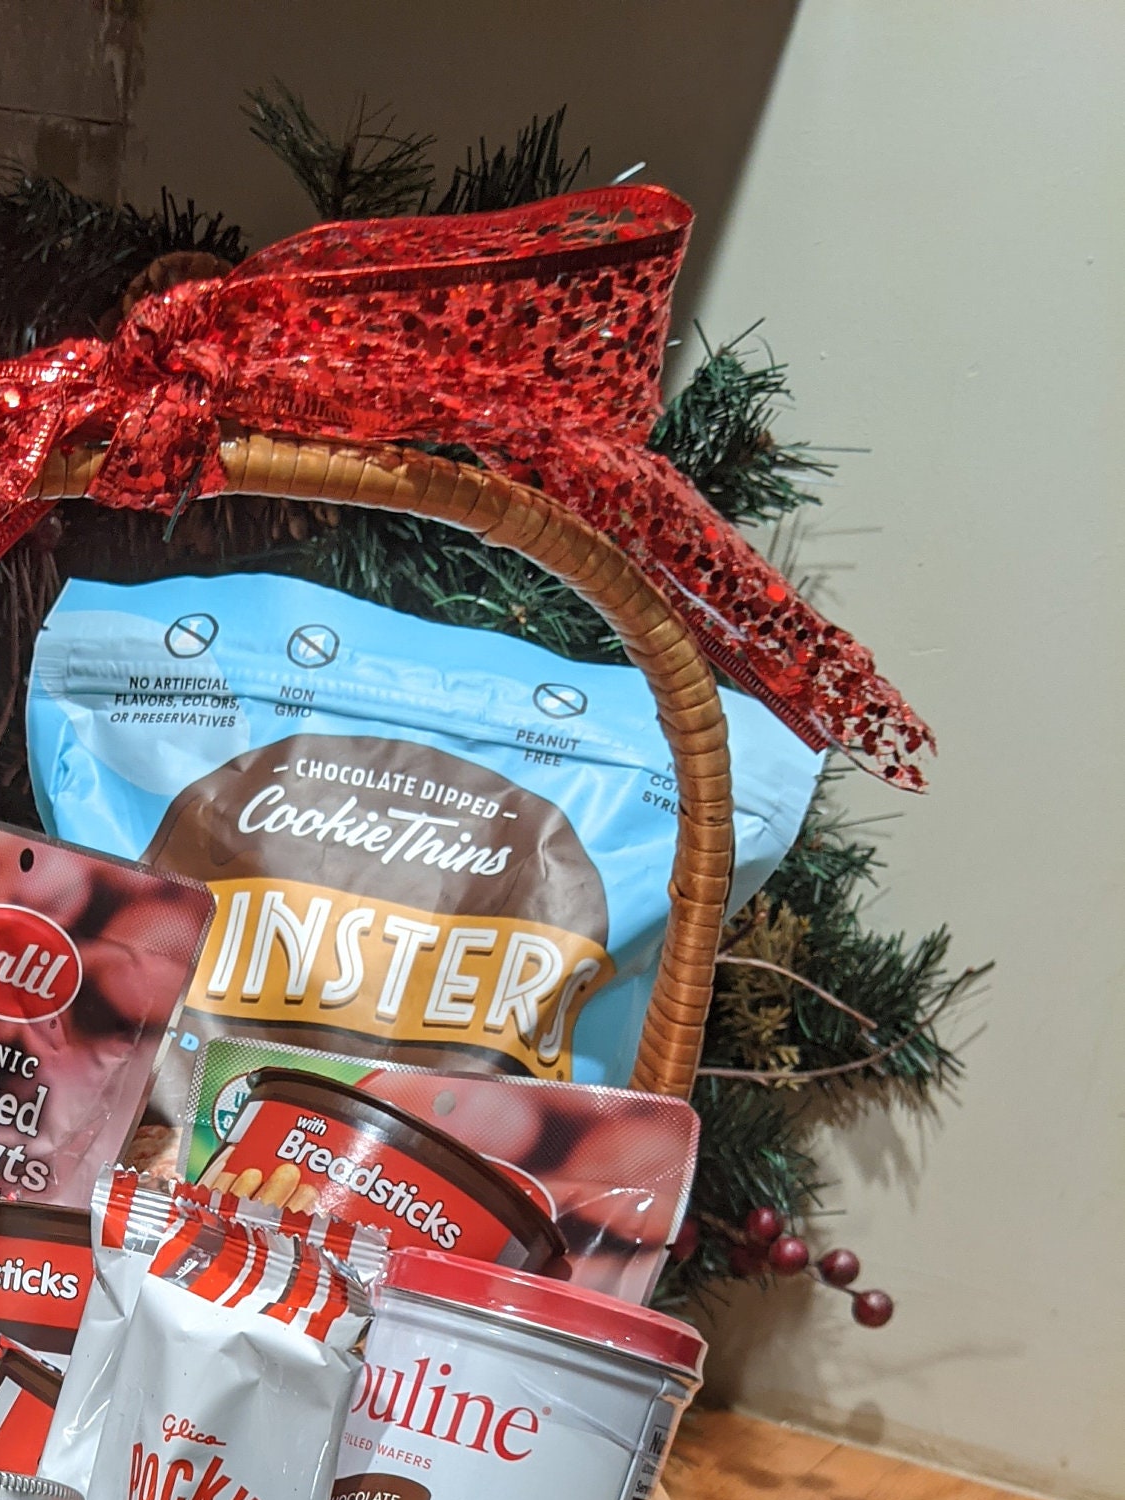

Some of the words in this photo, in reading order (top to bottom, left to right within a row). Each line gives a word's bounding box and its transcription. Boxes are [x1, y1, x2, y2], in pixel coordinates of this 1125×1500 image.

[128, 676, 150, 690] NO
[153, 677, 230, 691] ARTIFICIAL
[279, 685, 315, 702] NON
[109, 712, 130, 724] OR
[130, 712, 236, 728] PRESERVATIVES
[274, 702, 313, 718] GMO
[515, 728, 581, 751] PEANUT
[523, 749, 563, 767] FREE
[295, 758, 417, 797] CHOCOLATE
[420, 779, 500, 820] DIPPED
[641, 790, 678, 816] SYRU
[206, 889, 602, 1065] INSTERS
[296, 1115, 328, 1137] with
[276, 1127, 463, 1250] Breadsticks
[162, 1413, 227, 1446] Glico
[376, 1443, 433, 1470] WAFERS
